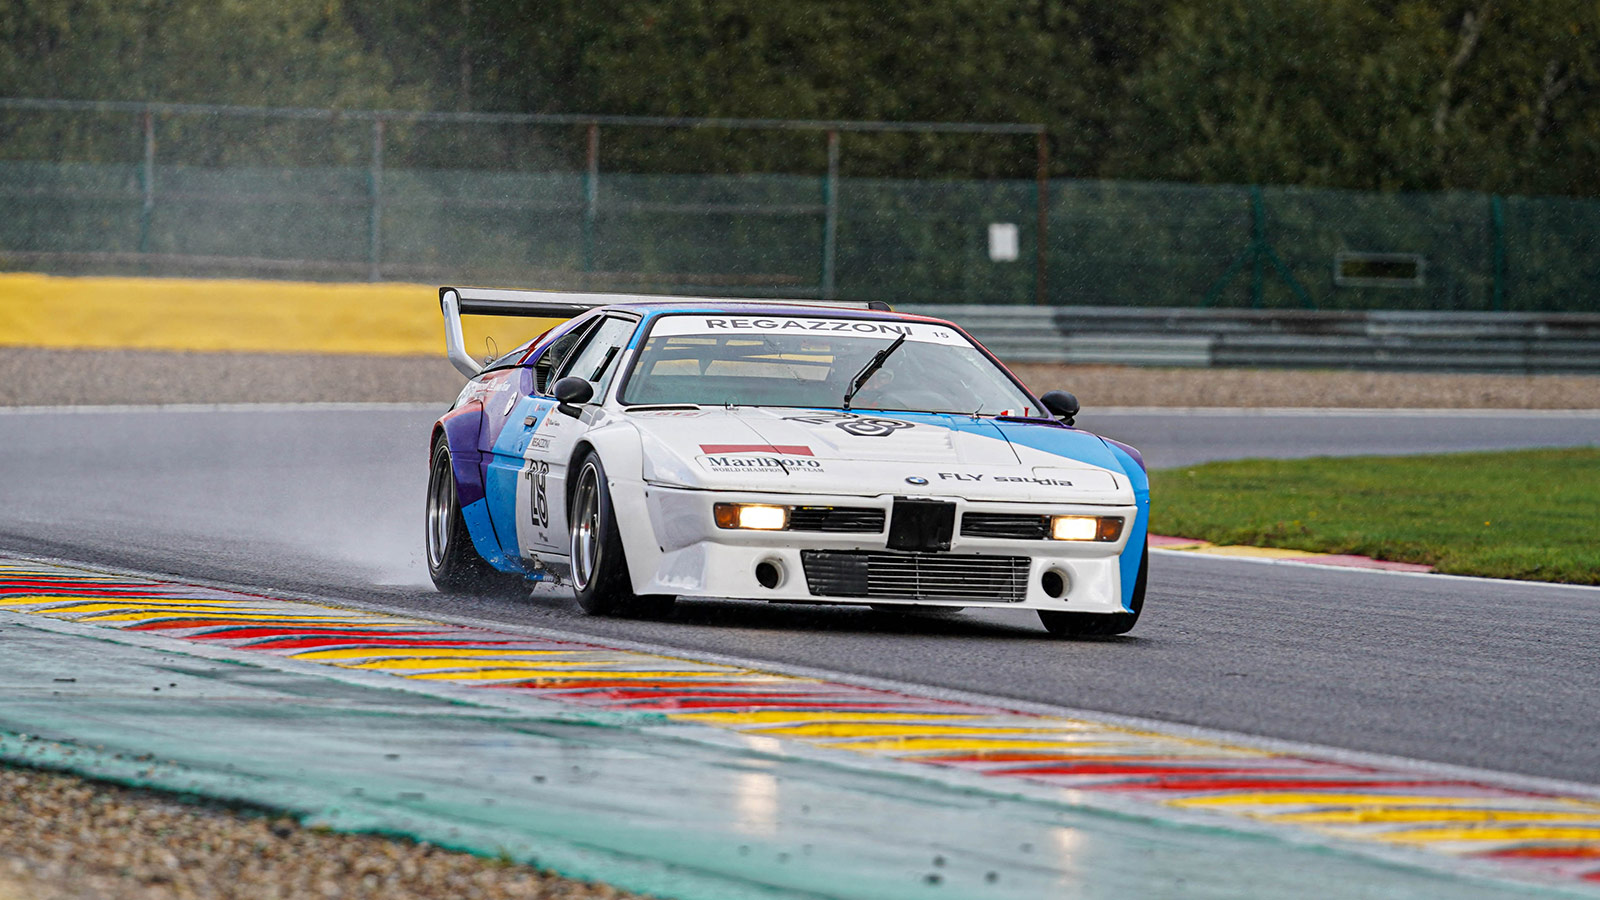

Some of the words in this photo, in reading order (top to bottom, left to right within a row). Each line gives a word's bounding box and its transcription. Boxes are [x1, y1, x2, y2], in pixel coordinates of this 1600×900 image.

[705, 319, 913, 336] REGAZZONI
[932, 331, 949, 339] 15
[707, 456, 820, 467] Marlboro
[937, 473, 983, 481] FLY
[993, 476, 1074, 487] saudia
[525, 458, 549, 529] 28
